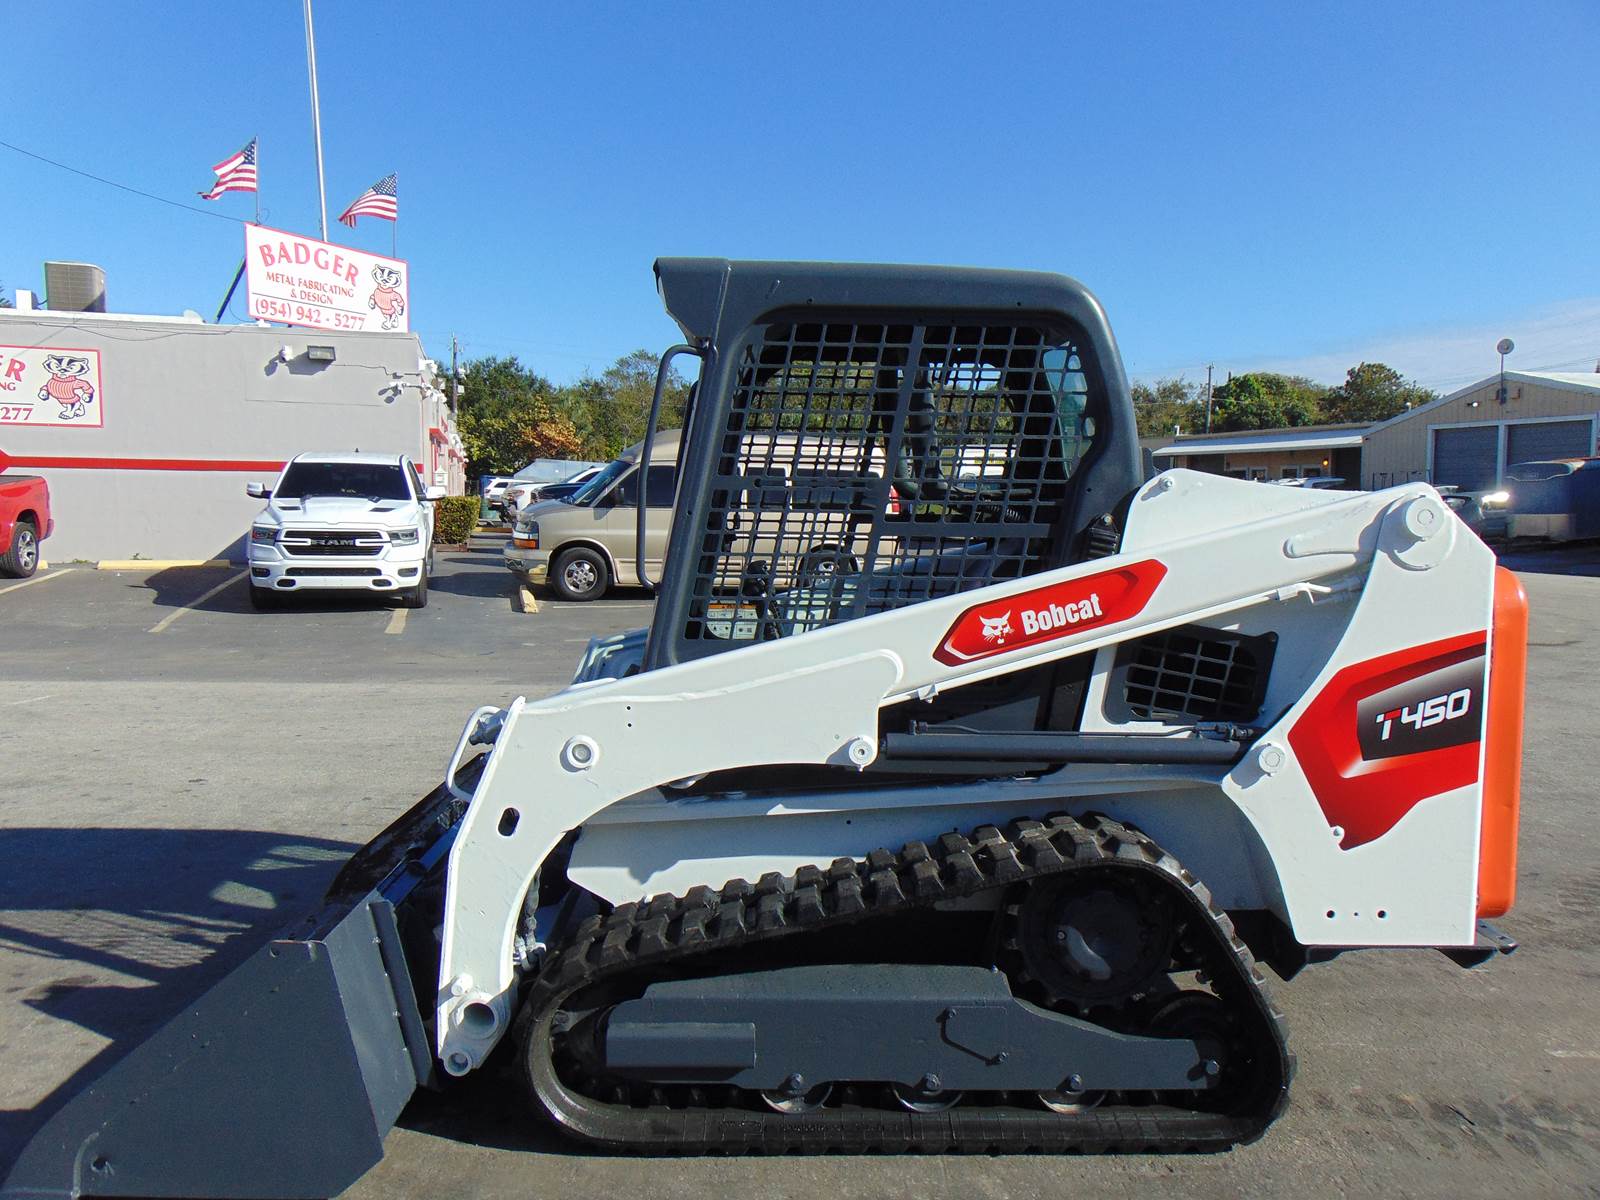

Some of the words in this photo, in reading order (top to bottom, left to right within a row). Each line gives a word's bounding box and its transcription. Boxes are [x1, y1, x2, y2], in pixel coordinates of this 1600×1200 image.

[259, 241, 359, 287] BADGER
[266, 271, 296, 287] METAL
[298, 277, 355, 298] FABRICATING
[290, 288, 298, 299] &
[300, 289, 334, 305] DESIGN
[255, 298, 292, 319] (954)
[296, 305, 322, 324] 942
[334, 312, 366, 331] 5277
[1020, 592, 1103, 636] Bobcat
[1375, 688, 1471, 741] T450
